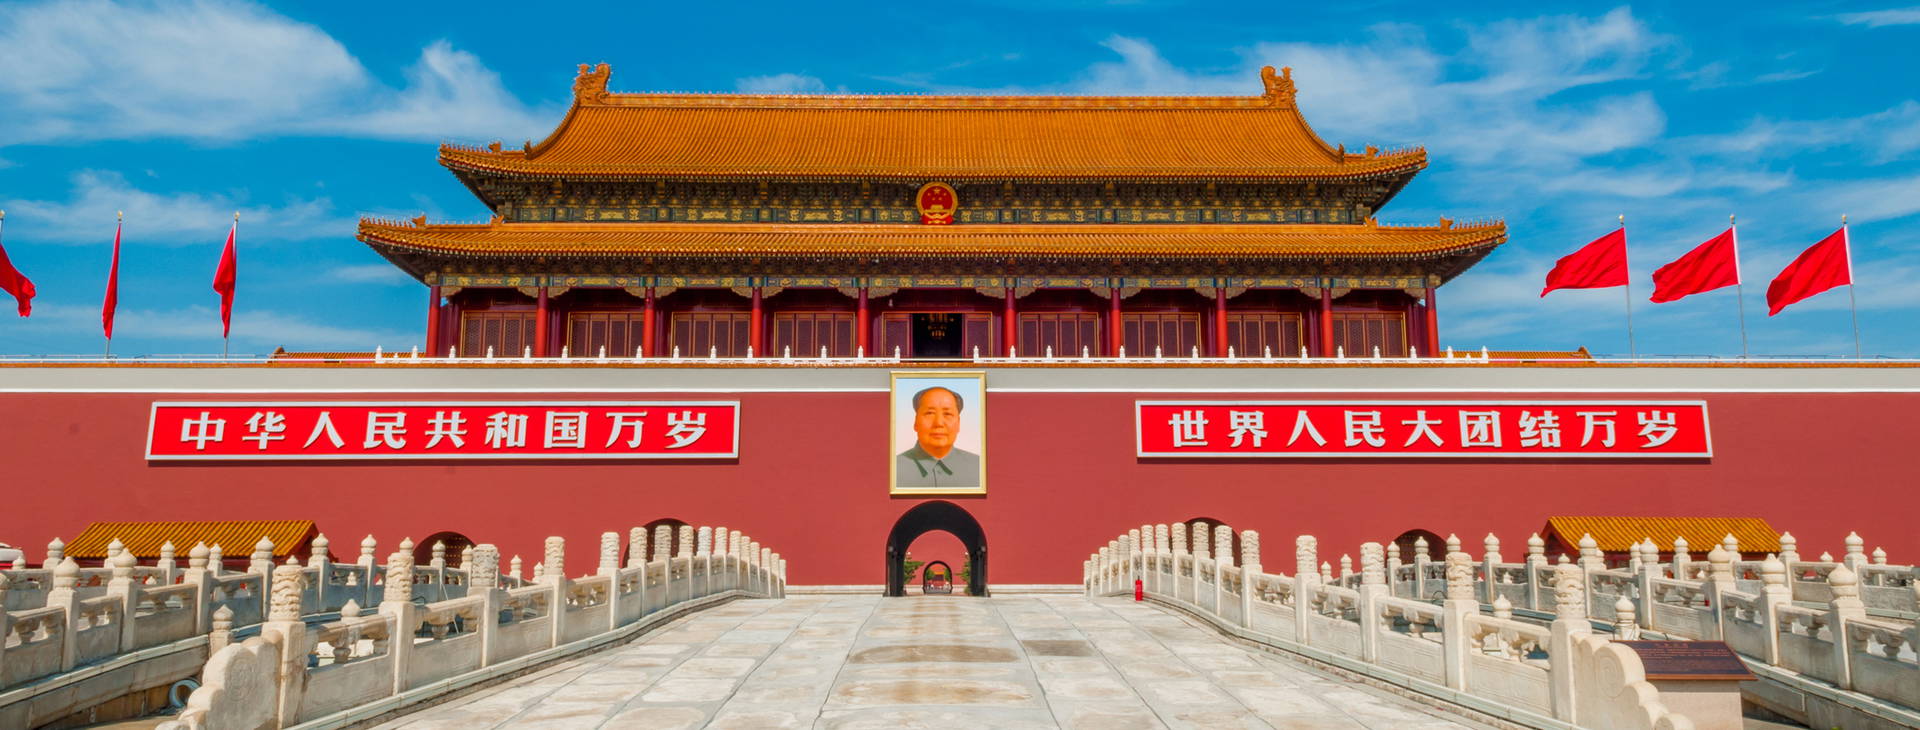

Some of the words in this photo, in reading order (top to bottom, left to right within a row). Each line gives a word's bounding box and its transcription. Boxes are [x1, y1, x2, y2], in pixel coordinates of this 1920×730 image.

[180, 410, 707, 450] 中华人民共和国万岁
[1167, 409, 1679, 448] 世界人民大团结万岁
